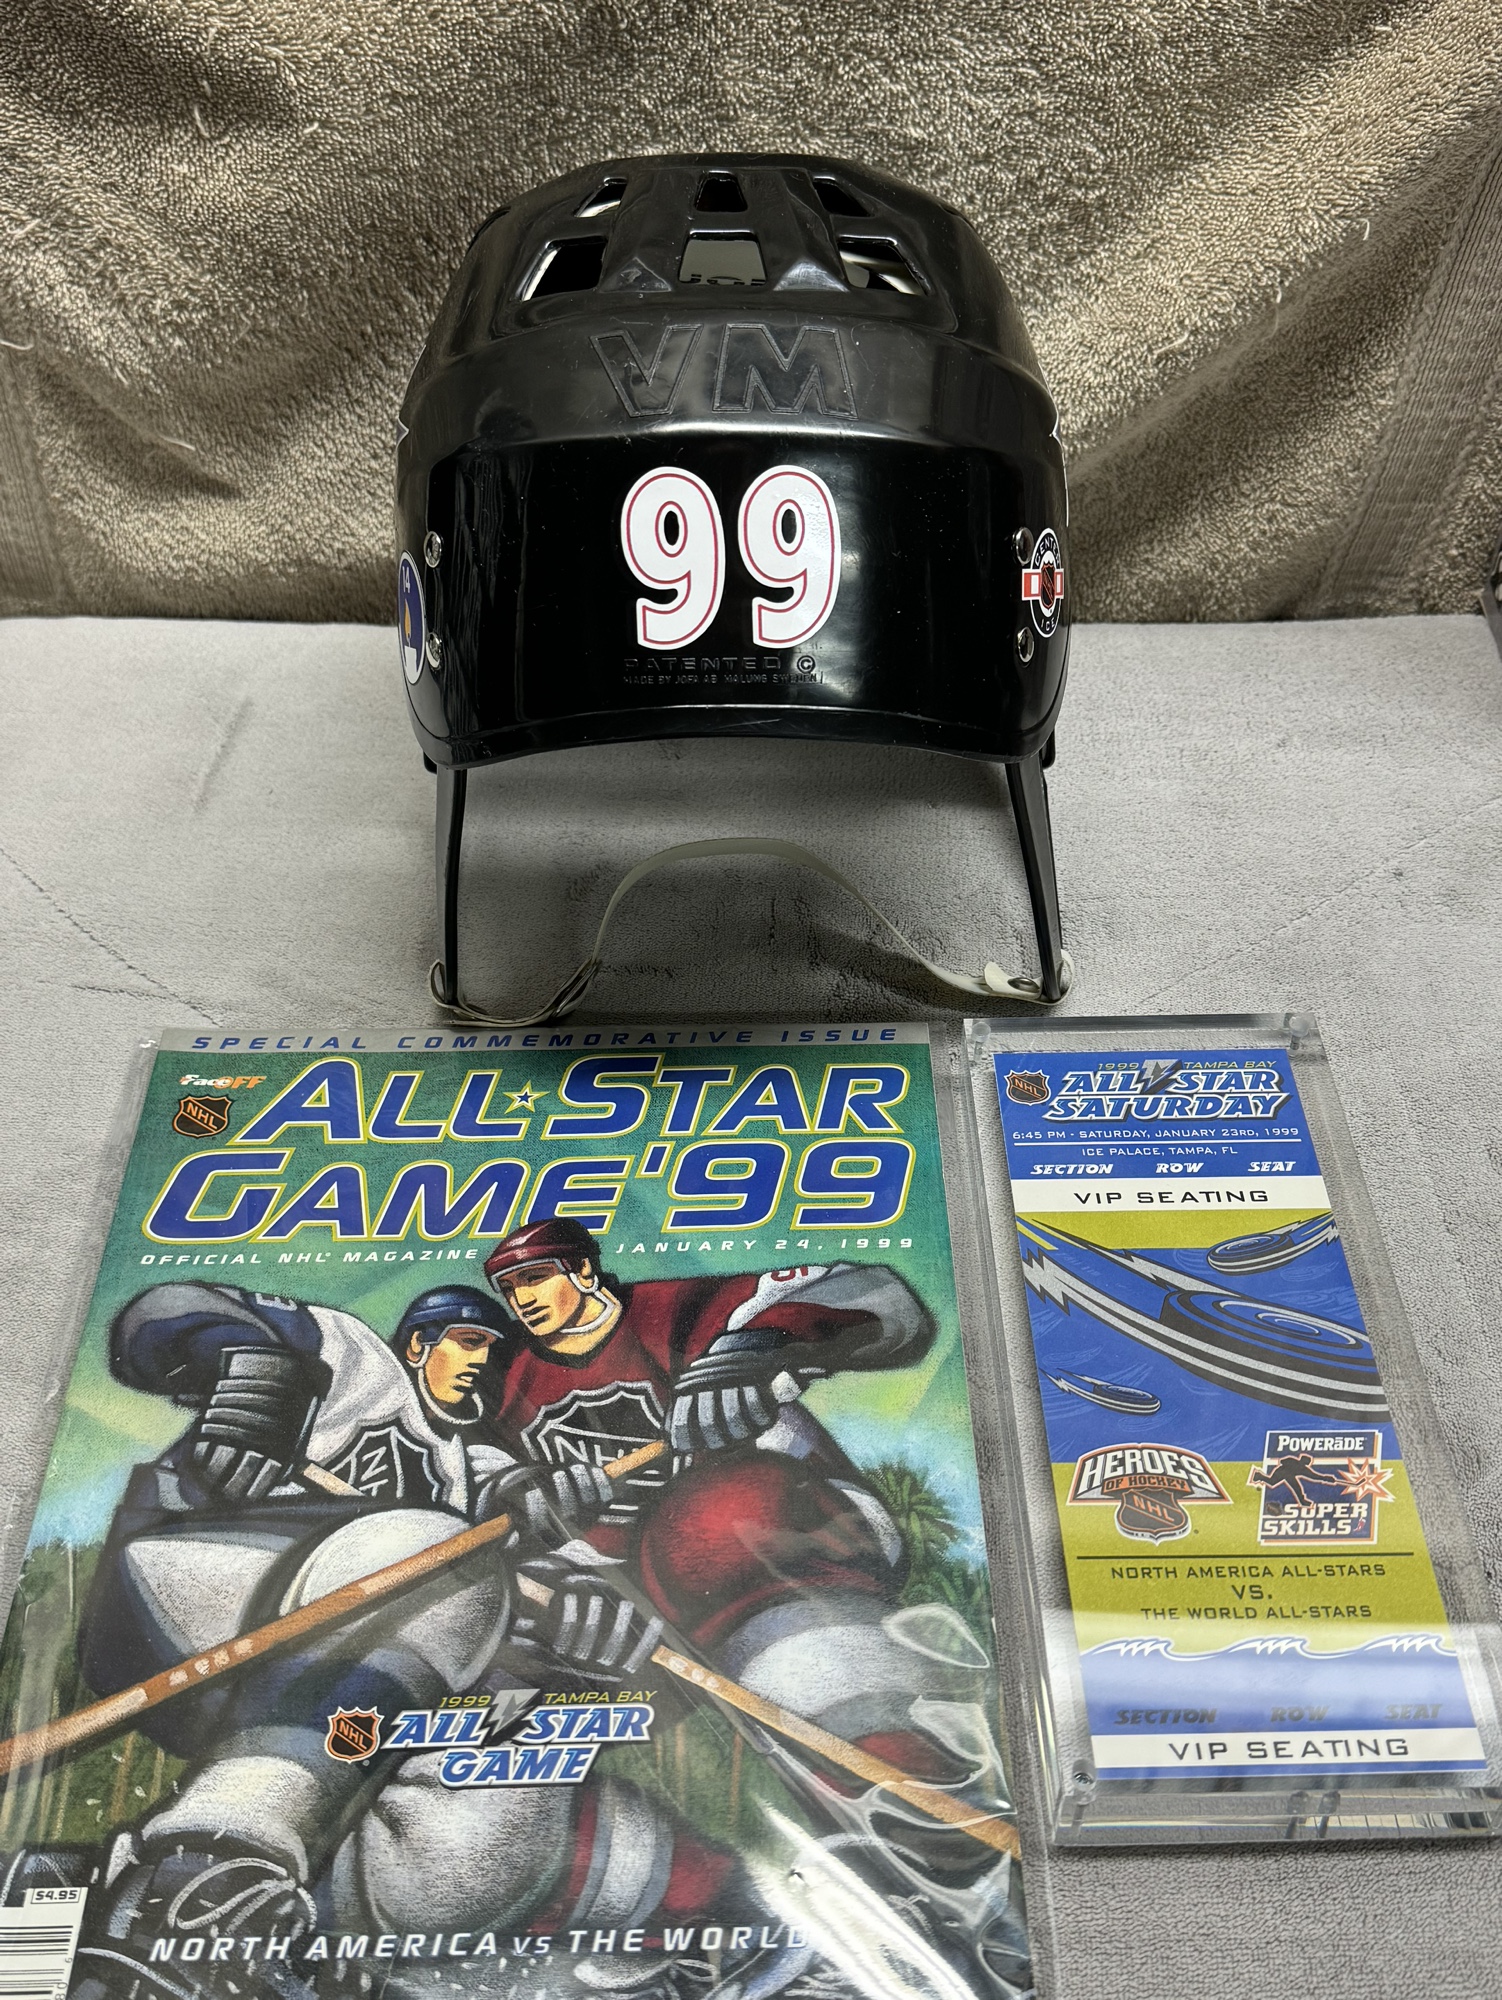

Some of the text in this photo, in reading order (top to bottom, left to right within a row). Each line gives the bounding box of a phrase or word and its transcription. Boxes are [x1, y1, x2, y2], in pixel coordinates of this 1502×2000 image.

[620, 464, 841, 651] 99
[1034, 535, 1061, 567] CENTER
[1040, 617, 1056, 632] ICE
[623, 655, 782, 672] PATENTED
[623, 674, 655, 685] MADE
[658, 674, 672, 685] BY
[675, 674, 700, 684] JOFA
[772, 672, 818, 684] SWEDEN
[191, 1028, 898, 1050] SPECIAL COMMEMORATIVE ISSUE
[1098, 1060, 1277, 1071] 1999 TAMPA BAY
[1013, 1078, 1042, 1099] NHL
[1058, 1069, 1282, 1095] ALL STAR
[226, 1052, 910, 1146] ALL STAR
[1042, 1093, 1290, 1121] SATURDAY
[185, 1101, 218, 1130] NHL
[1012, 1131, 1043, 1140] 6:45
[1047, 1131, 1066, 1139] PM
[1079, 1129, 1151, 1139] SATURDAY,
[1155, 1128, 1217, 1138] JANUARY
[1221, 1128, 1260, 1138] 23RD,
[1264, 1127, 1299, 1136] 1999
[1082, 1146, 1239, 1157] ICE PALACE, TAMPA, FL
[1030, 1160, 1297, 1175] SECTION ROW SEAT
[1073, 1189, 1270, 1205] VIP SEATING
[140, 1253, 262, 1265] OFFICIAL
[343, 1248, 479, 1263] MAGAZINE
[615, 1239, 758, 1254] JANUARY
[774, 1238, 824, 1252] 24,
[840, 1236, 914, 1250] 1999
[1076, 1448, 1221, 1495] HEROES
[1105, 1474, 1187, 1491] OF HOCKEY
[1132, 1494, 1175, 1523] NHL
[1284, 1502, 1369, 1519] SUPER
[1261, 1518, 1352, 1536] SKILLS
[1110, 1563, 1387, 1580] NORTH AMERICA ALL-STARS
[1230, 1584, 1274, 1600] VS.
[1141, 1604, 1372, 1621] THE WORLD ALL-STARS
[439, 1689, 658, 1708] 1999 TAMPA BAY
[1114, 1703, 1443, 1725] SECTION ROW SEAT
[337, 1719, 368, 1750] NHL
[381, 1704, 655, 1749] ALL STAR
[1168, 1738, 1410, 1761] VIP SEATING
[440, 1743, 601, 1787] GAME
[149, 1936, 292, 1962] NORTH
[304, 1931, 499, 1960] AMERICA
[569, 1928, 647, 1953] THE
[662, 1926, 809, 1950] WORLD
